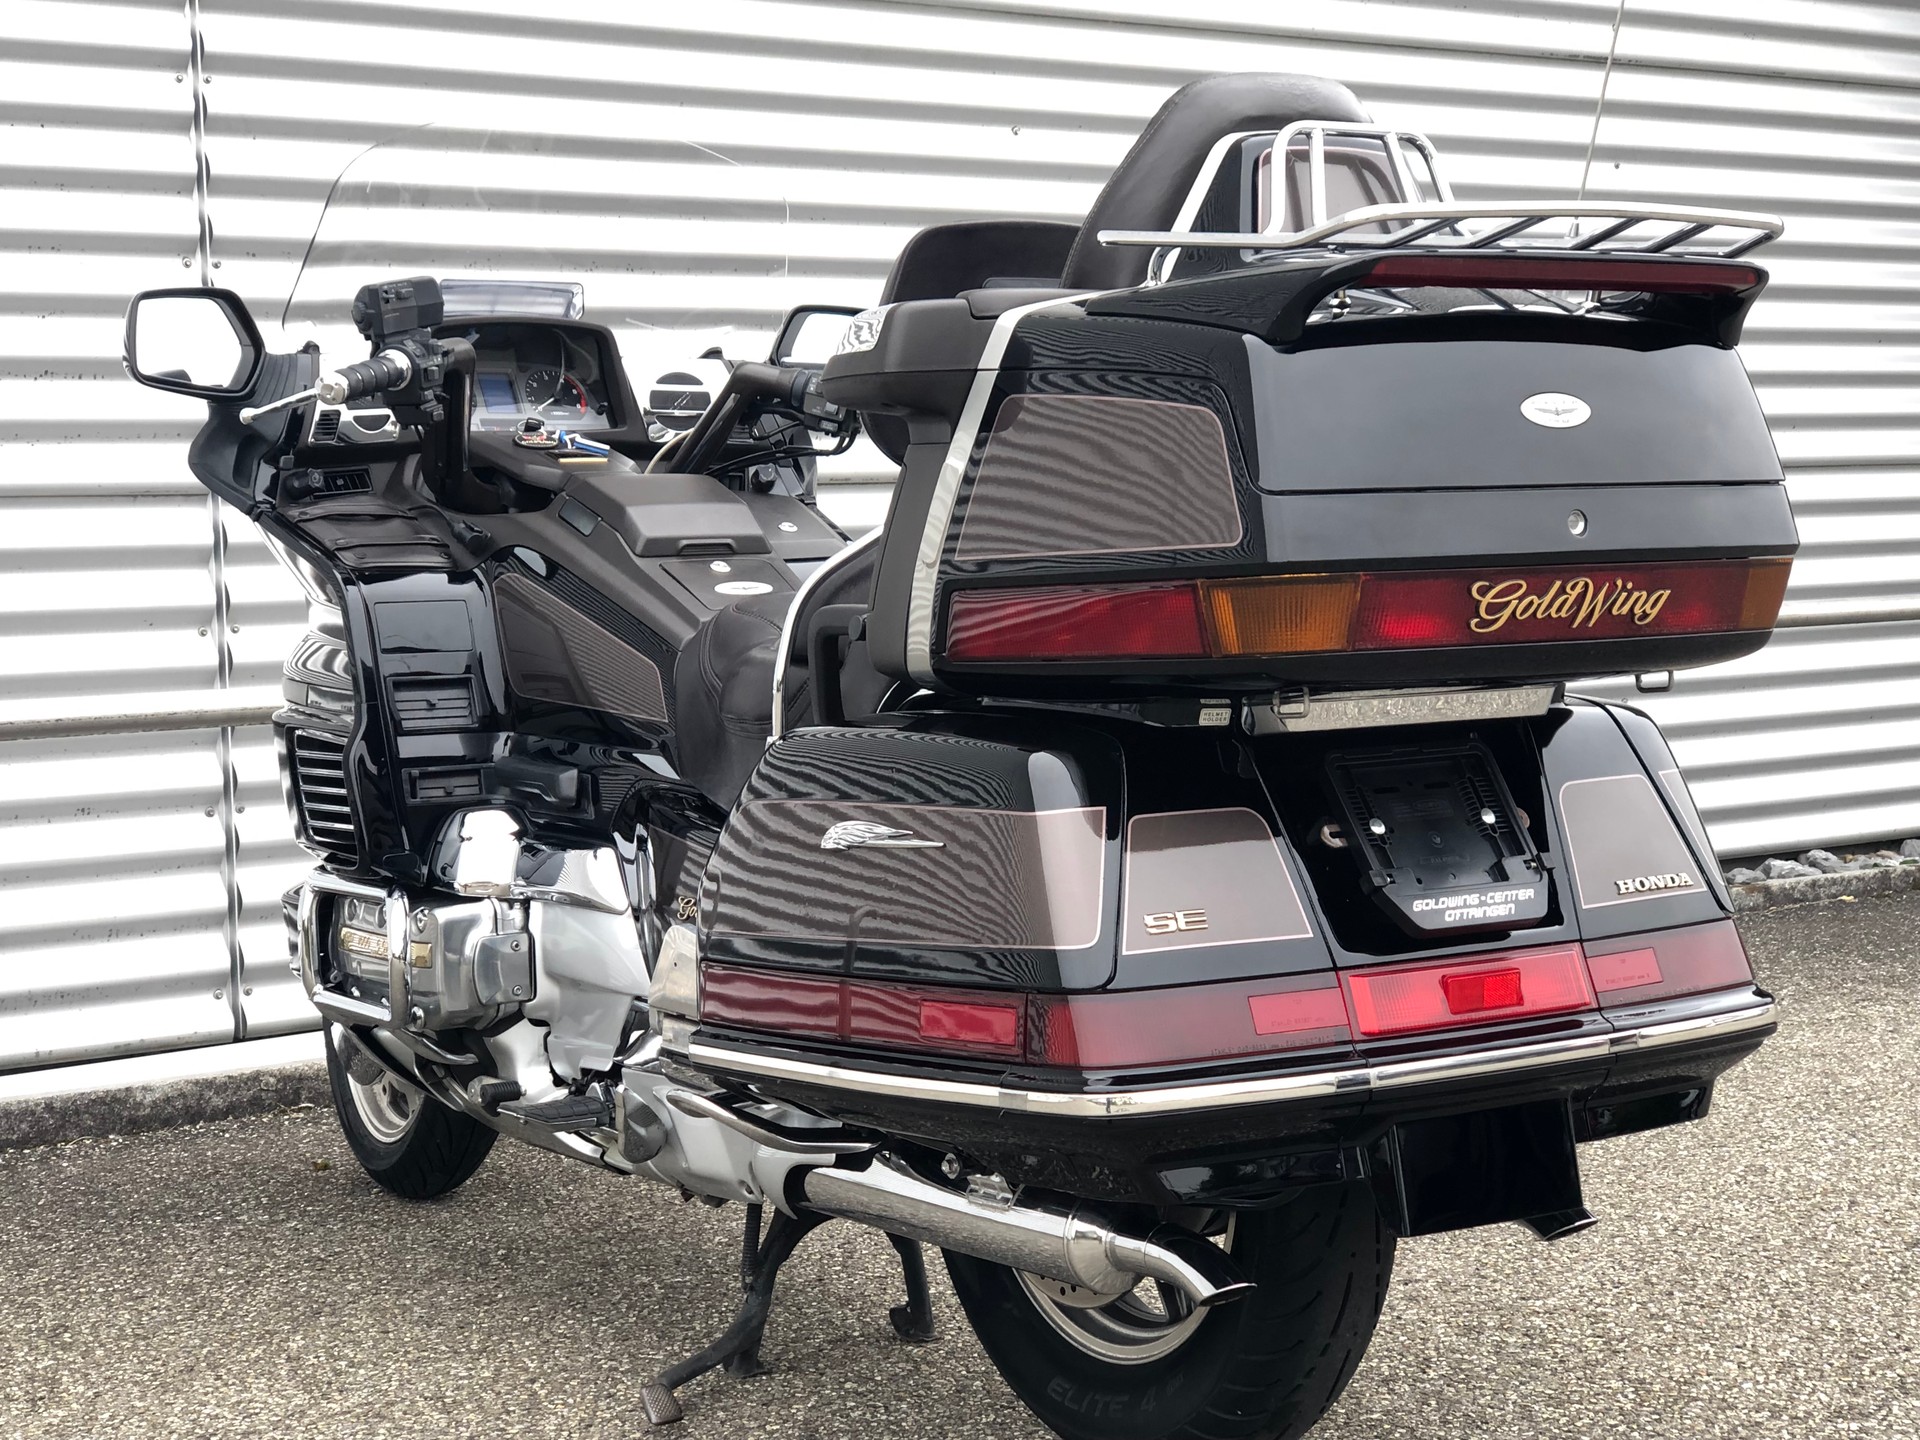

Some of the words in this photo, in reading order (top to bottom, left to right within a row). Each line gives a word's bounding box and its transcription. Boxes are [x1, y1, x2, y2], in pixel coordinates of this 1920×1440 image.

[1615, 872, 1694, 895] HONDA
[677, 896, 698, 920] Go
[1143, 909, 1208, 935] SE
[1047, 1376, 1130, 1418] ELITE
[1140, 1385, 1157, 1412] 4
